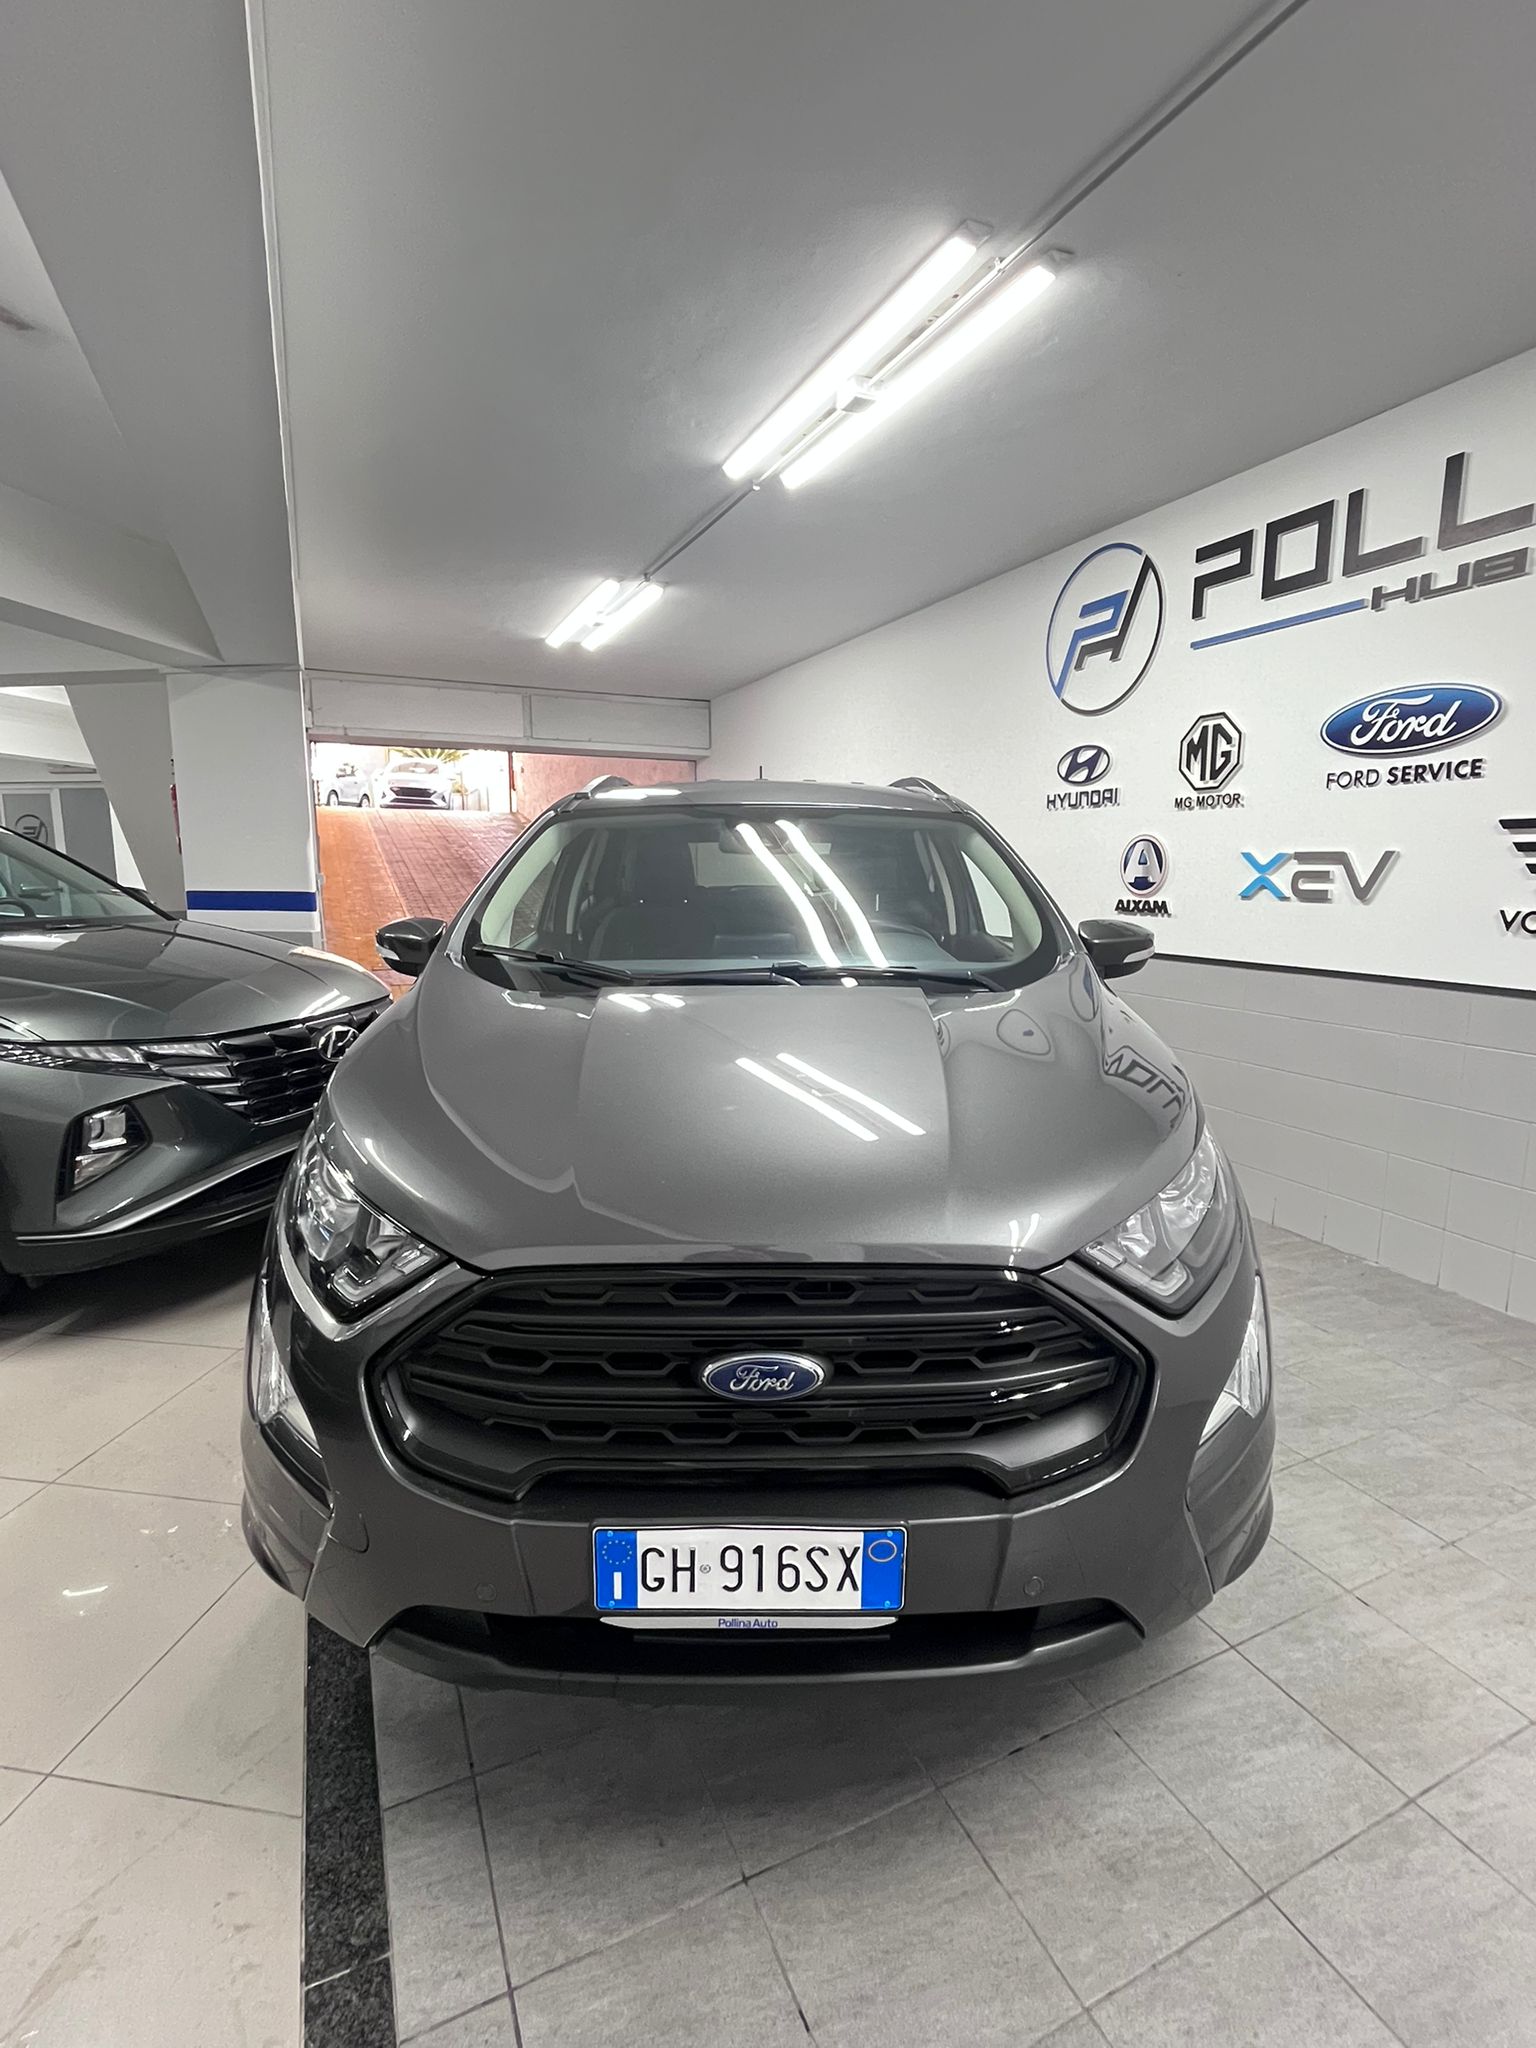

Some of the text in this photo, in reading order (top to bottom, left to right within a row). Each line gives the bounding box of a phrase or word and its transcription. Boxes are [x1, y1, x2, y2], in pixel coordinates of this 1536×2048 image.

[1192, 452, 1535, 620] POLL
[1371, 547, 1531, 611] HUB
[1350, 693, 1463, 747] Ford
[1186, 721, 1235, 782] MG
[1326, 758, 1483, 789] FORD SERVICE
[1047, 788, 1119, 810] HYUNDAI
[1174, 793, 1242, 809] MG MOTOR
[1238, 851, 1399, 902] XEV
[1114, 899, 1170, 915] AIXAM
[729, 1365, 794, 1392] Ford
[640, 1544, 862, 1593] GH 916SX
[718, 1618, 778, 1628] Pollina Auto
